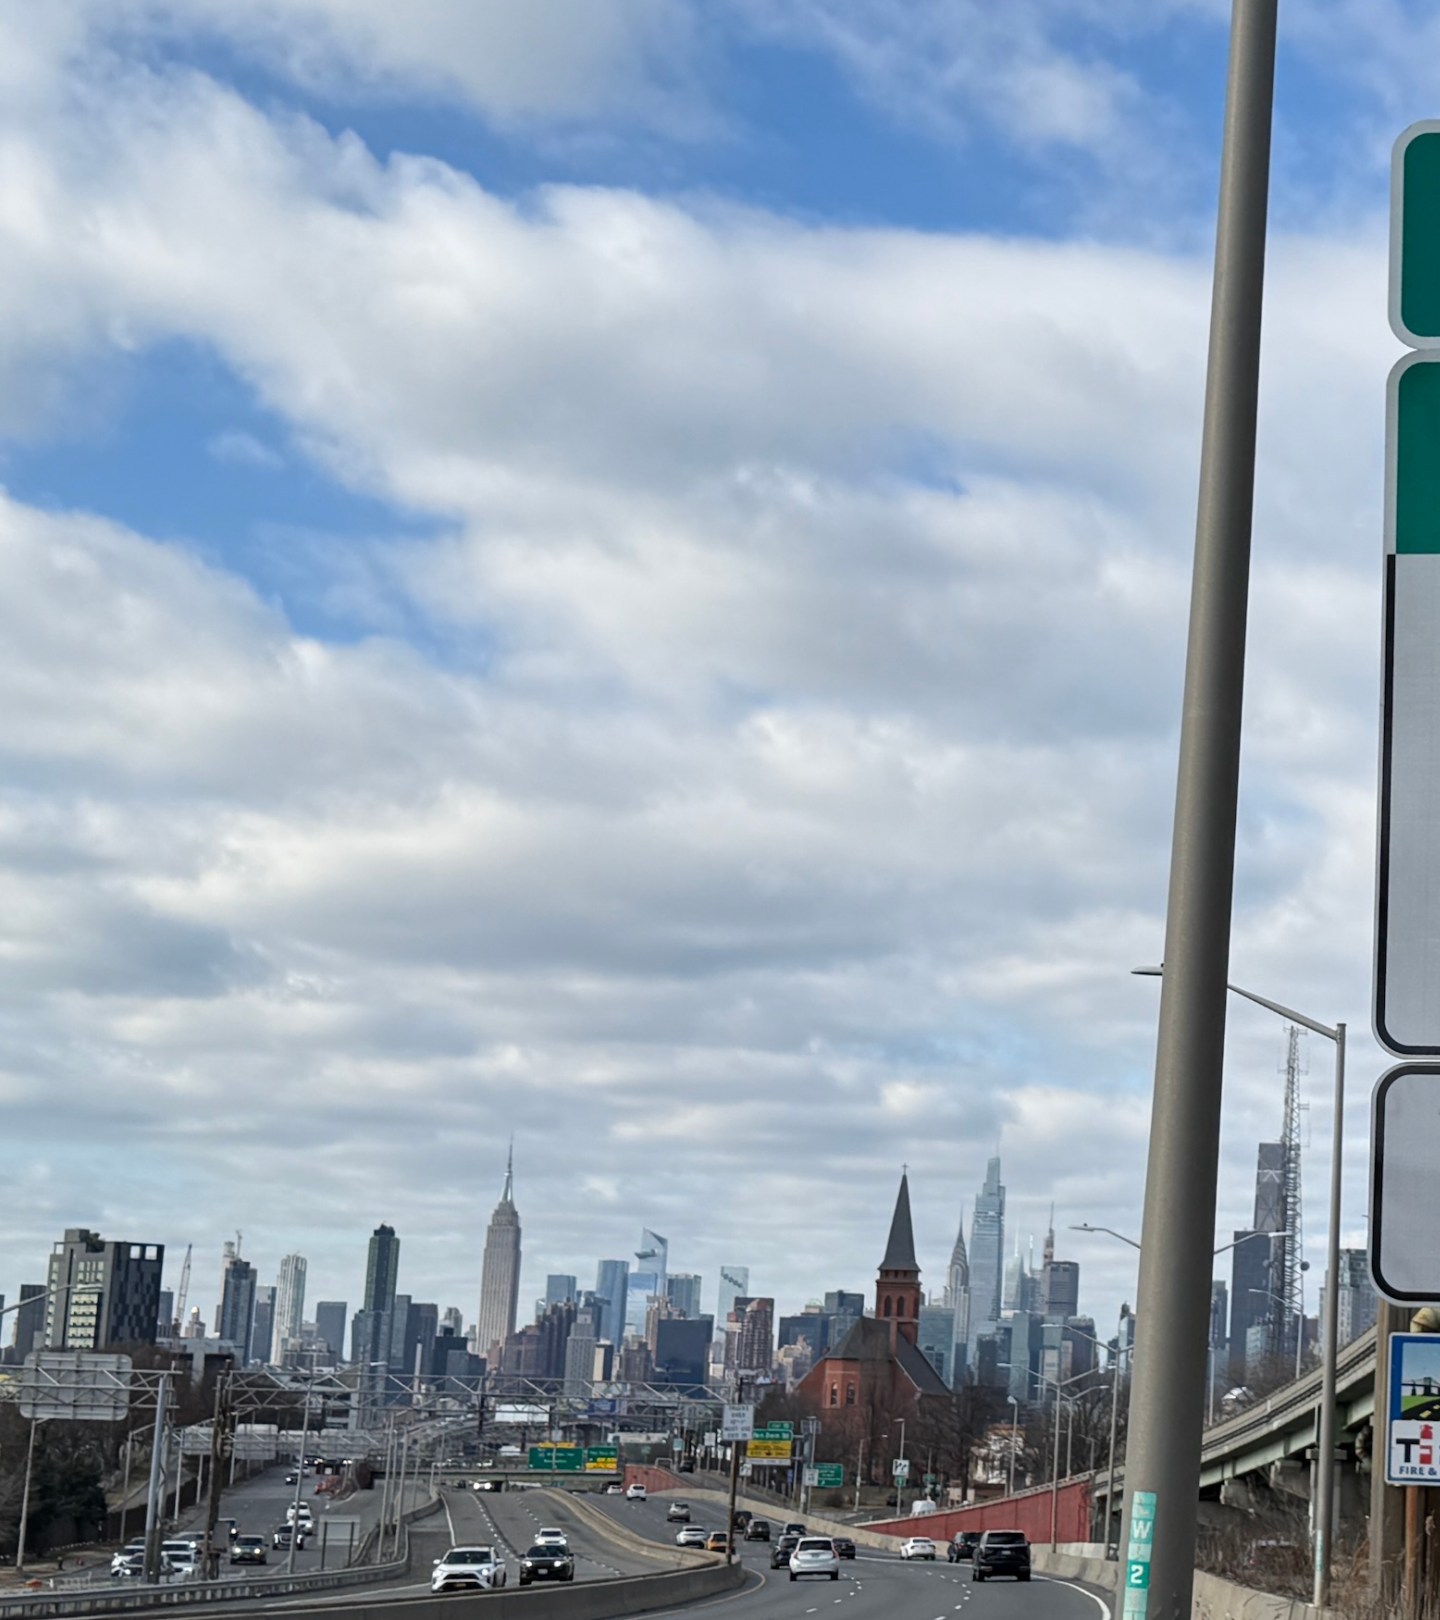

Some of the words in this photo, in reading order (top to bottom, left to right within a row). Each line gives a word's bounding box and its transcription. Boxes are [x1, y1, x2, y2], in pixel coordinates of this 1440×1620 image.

[1399, 1466, 1424, 1476] FIRE
[1428, 1467, 1437, 1476] &
[1132, 1520, 1153, 1540] W
[1129, 1564, 1144, 1584] 2
